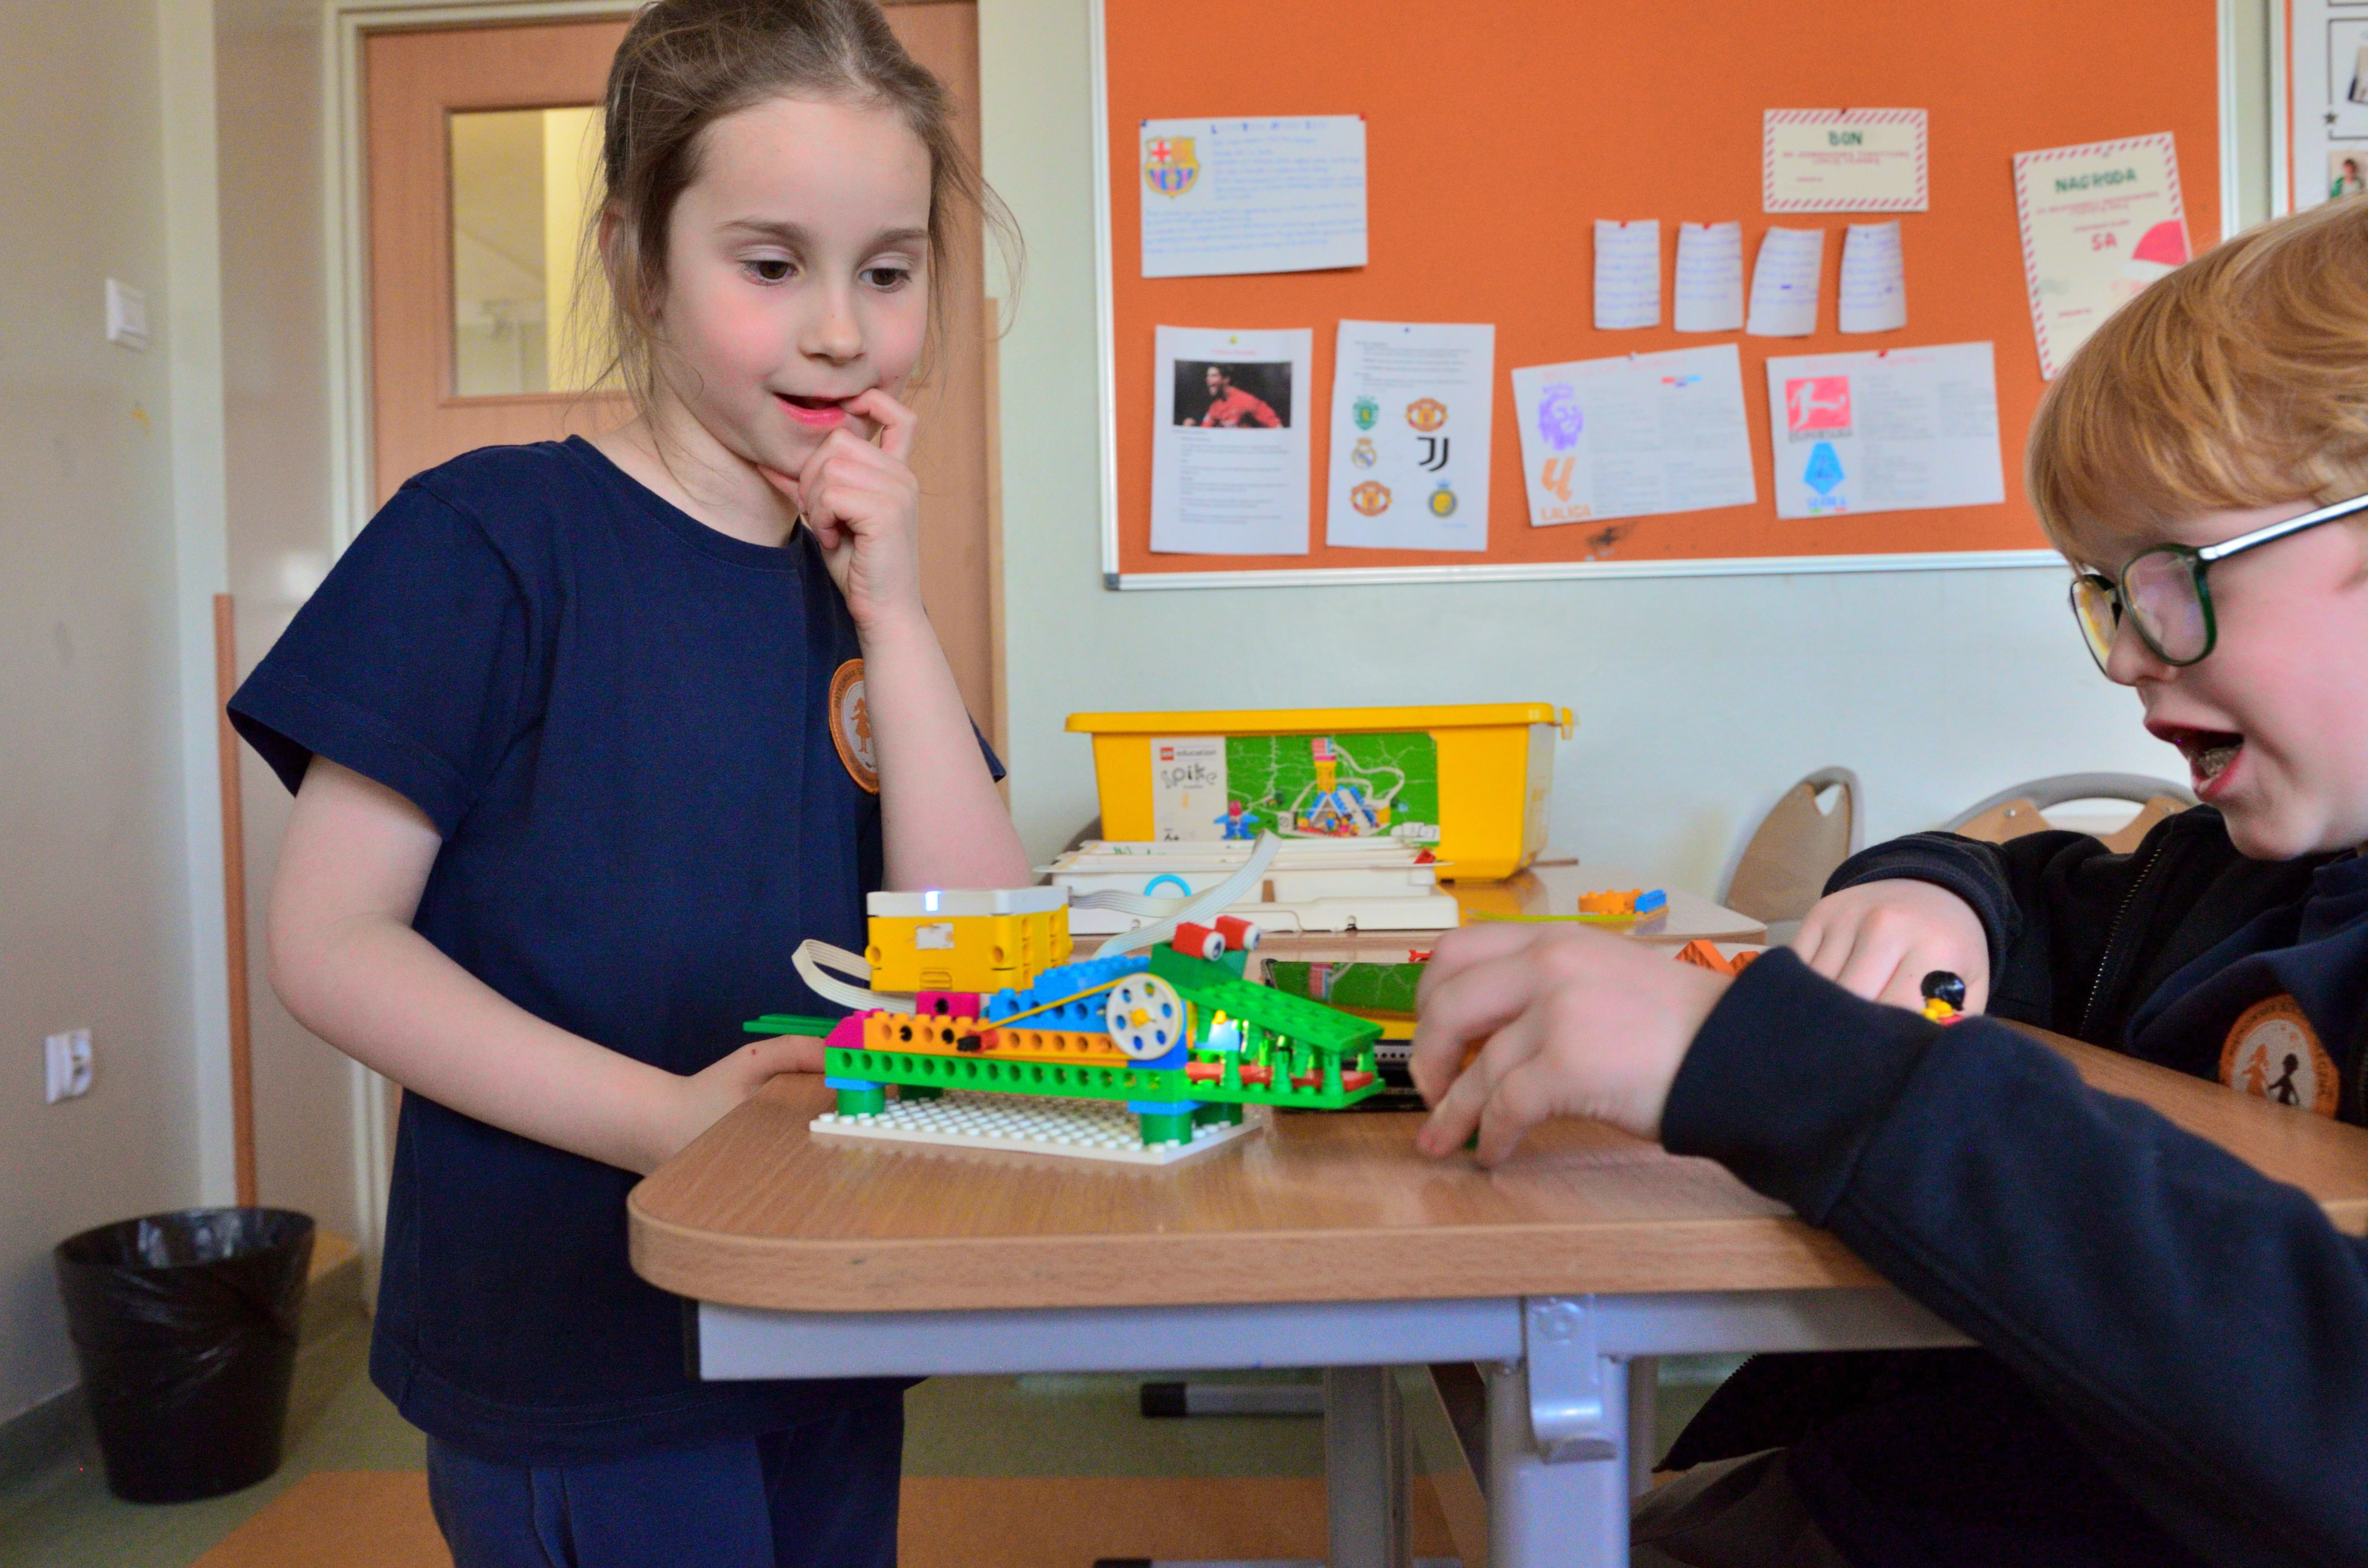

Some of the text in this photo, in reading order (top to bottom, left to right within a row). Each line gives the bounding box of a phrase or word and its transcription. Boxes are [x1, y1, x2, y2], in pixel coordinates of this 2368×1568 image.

[1828, 130, 1863, 146] BON
[2054, 167, 2137, 193] NAGRODA
[1161, 763, 1217, 789] spike
